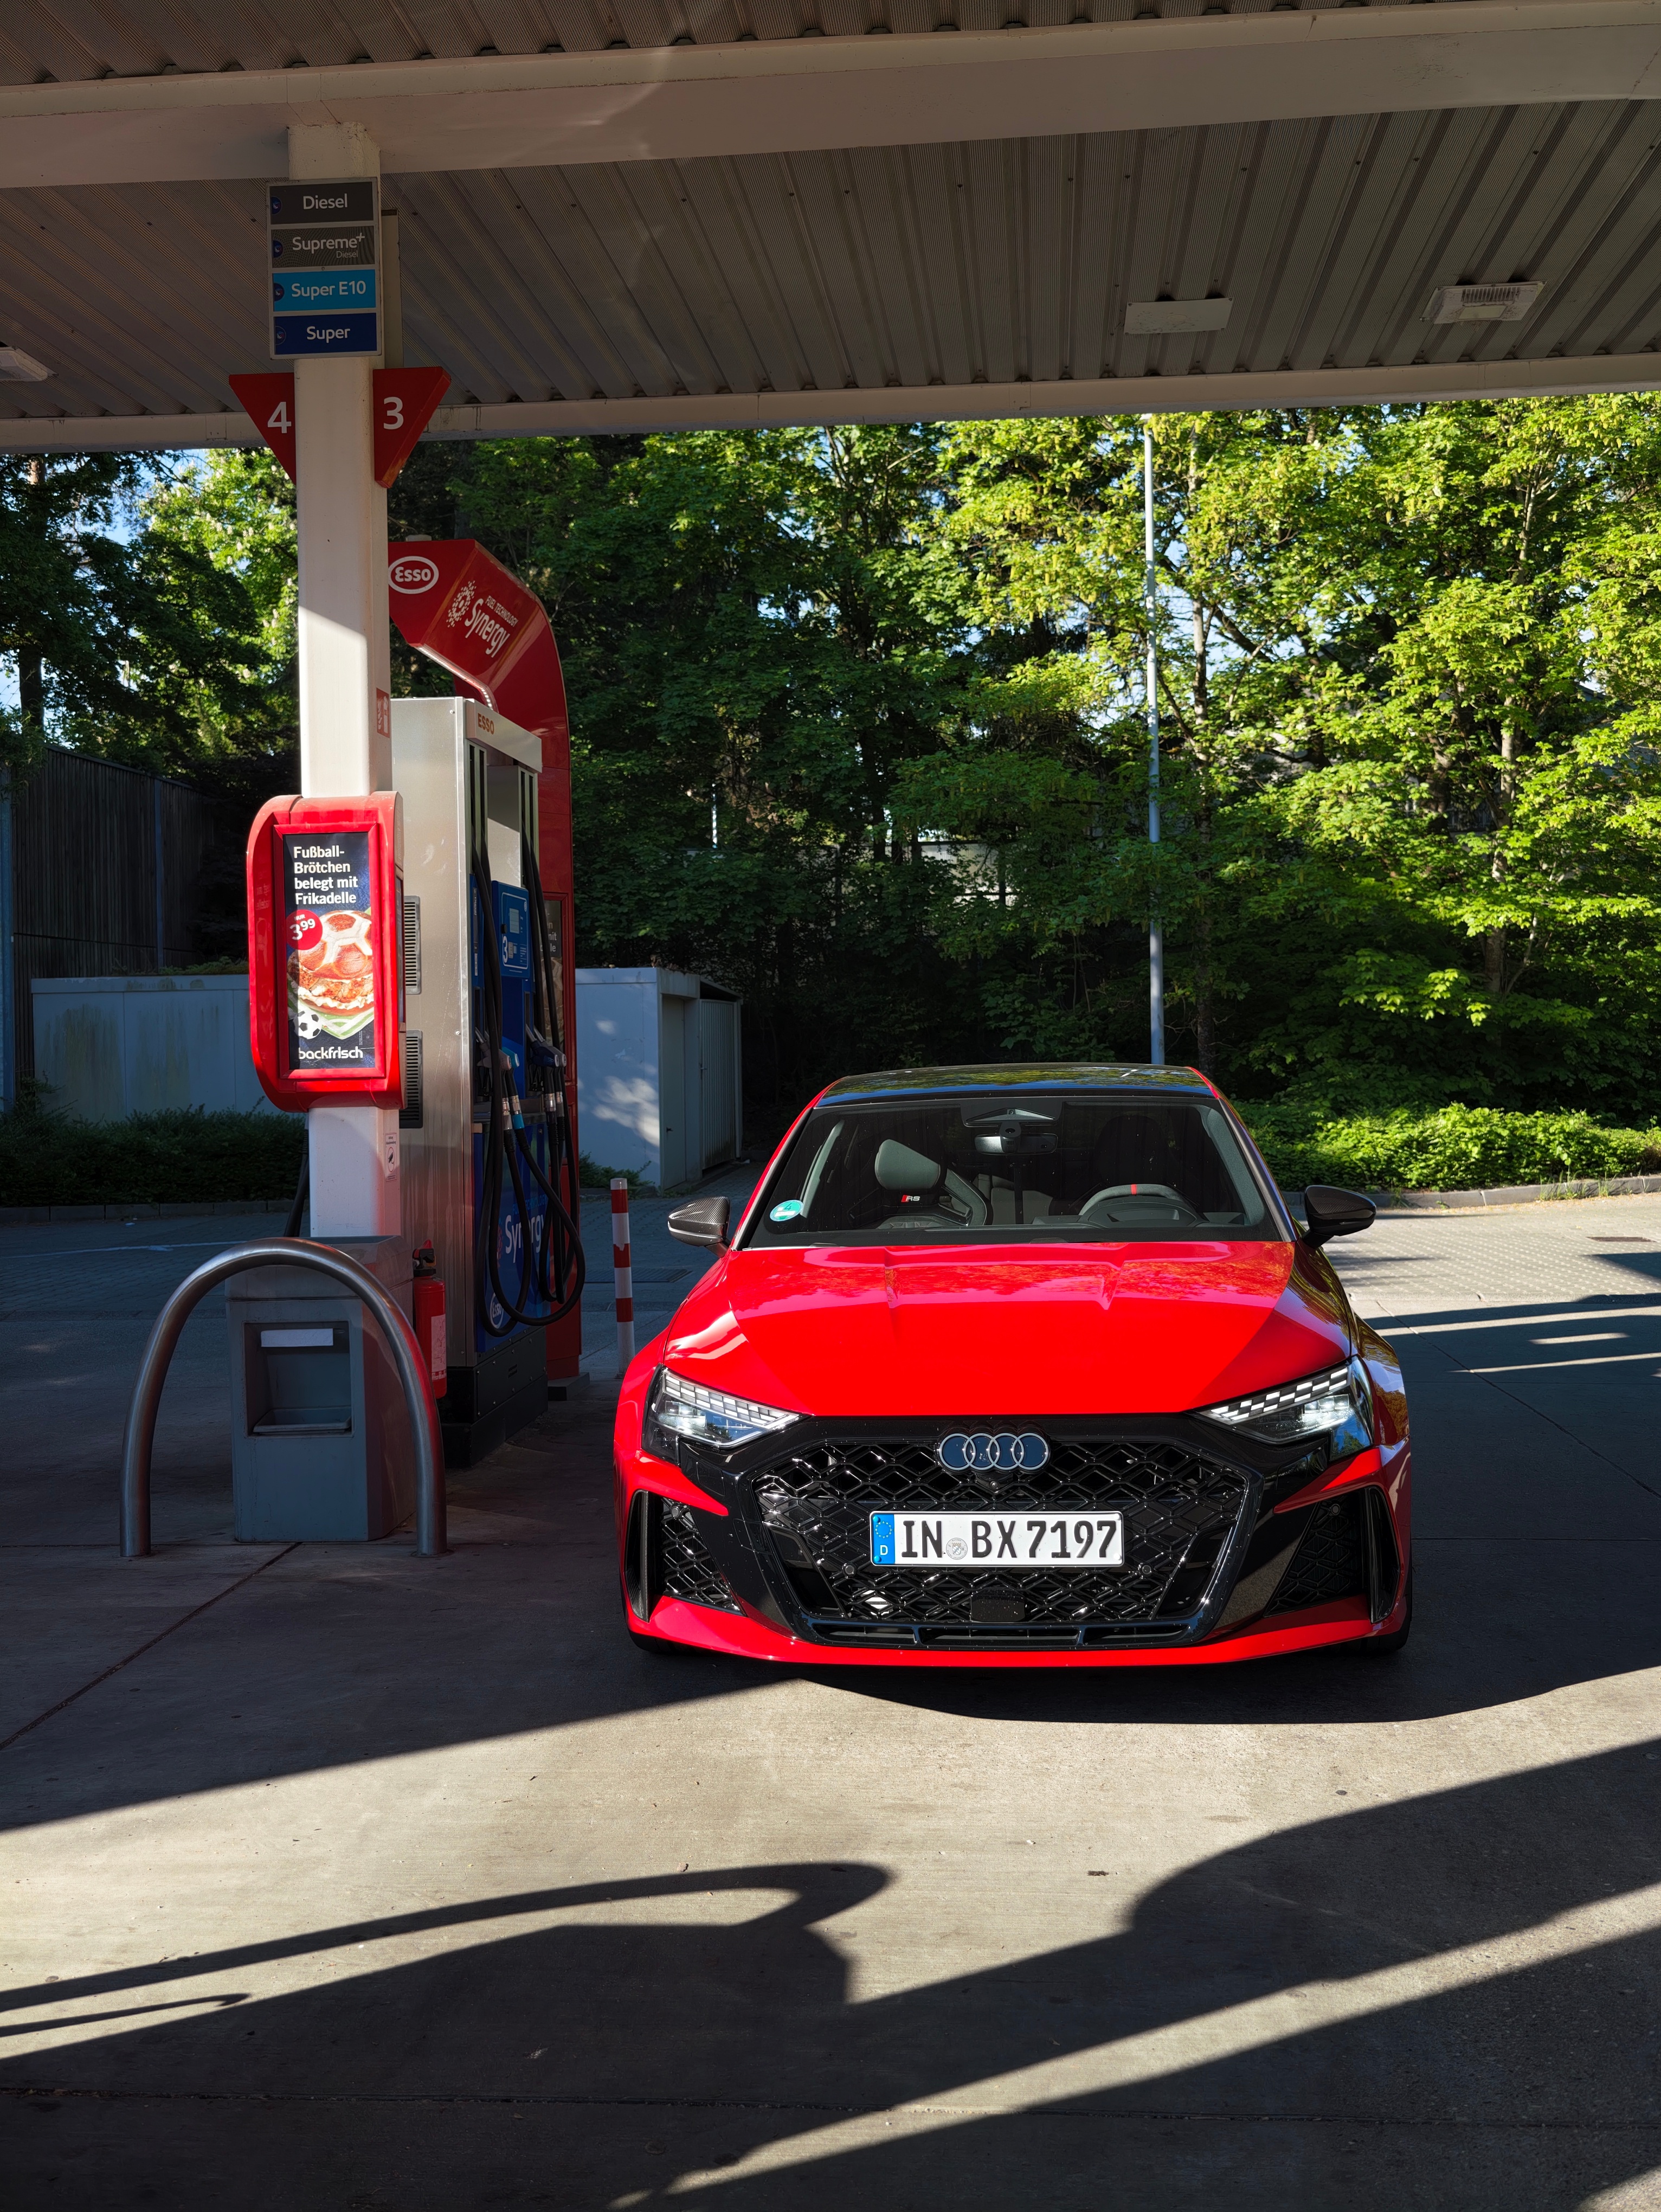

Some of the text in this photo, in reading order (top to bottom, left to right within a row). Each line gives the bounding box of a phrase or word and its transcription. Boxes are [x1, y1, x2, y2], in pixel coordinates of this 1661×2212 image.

[303, 193, 347, 210] Diesel
[336, 250, 358, 258] Diesel
[291, 280, 366, 300] Super E10
[306, 326, 350, 343] Super
[267, 401, 292, 434] 4
[383, 396, 404, 430] 3
[395, 567, 431, 582] Esso
[485, 595, 519, 627] FUEL TECHNOLOGY
[465, 598, 510, 658] Synergy
[478, 712, 494, 735] ESSO
[294, 845, 345, 858] Fußball-
[294, 861, 351, 874] Brötchen
[294, 876, 358, 891] belegt mit
[295, 891, 357, 905] Frikadelle
[503, 936, 508, 963] 3
[298, 1046, 363, 1059] backfrisch
[492, 1302, 502, 1319] Esso
[902, 1520, 1117, 1558] IN BX 7197
[879, 1544, 889, 1556] D
